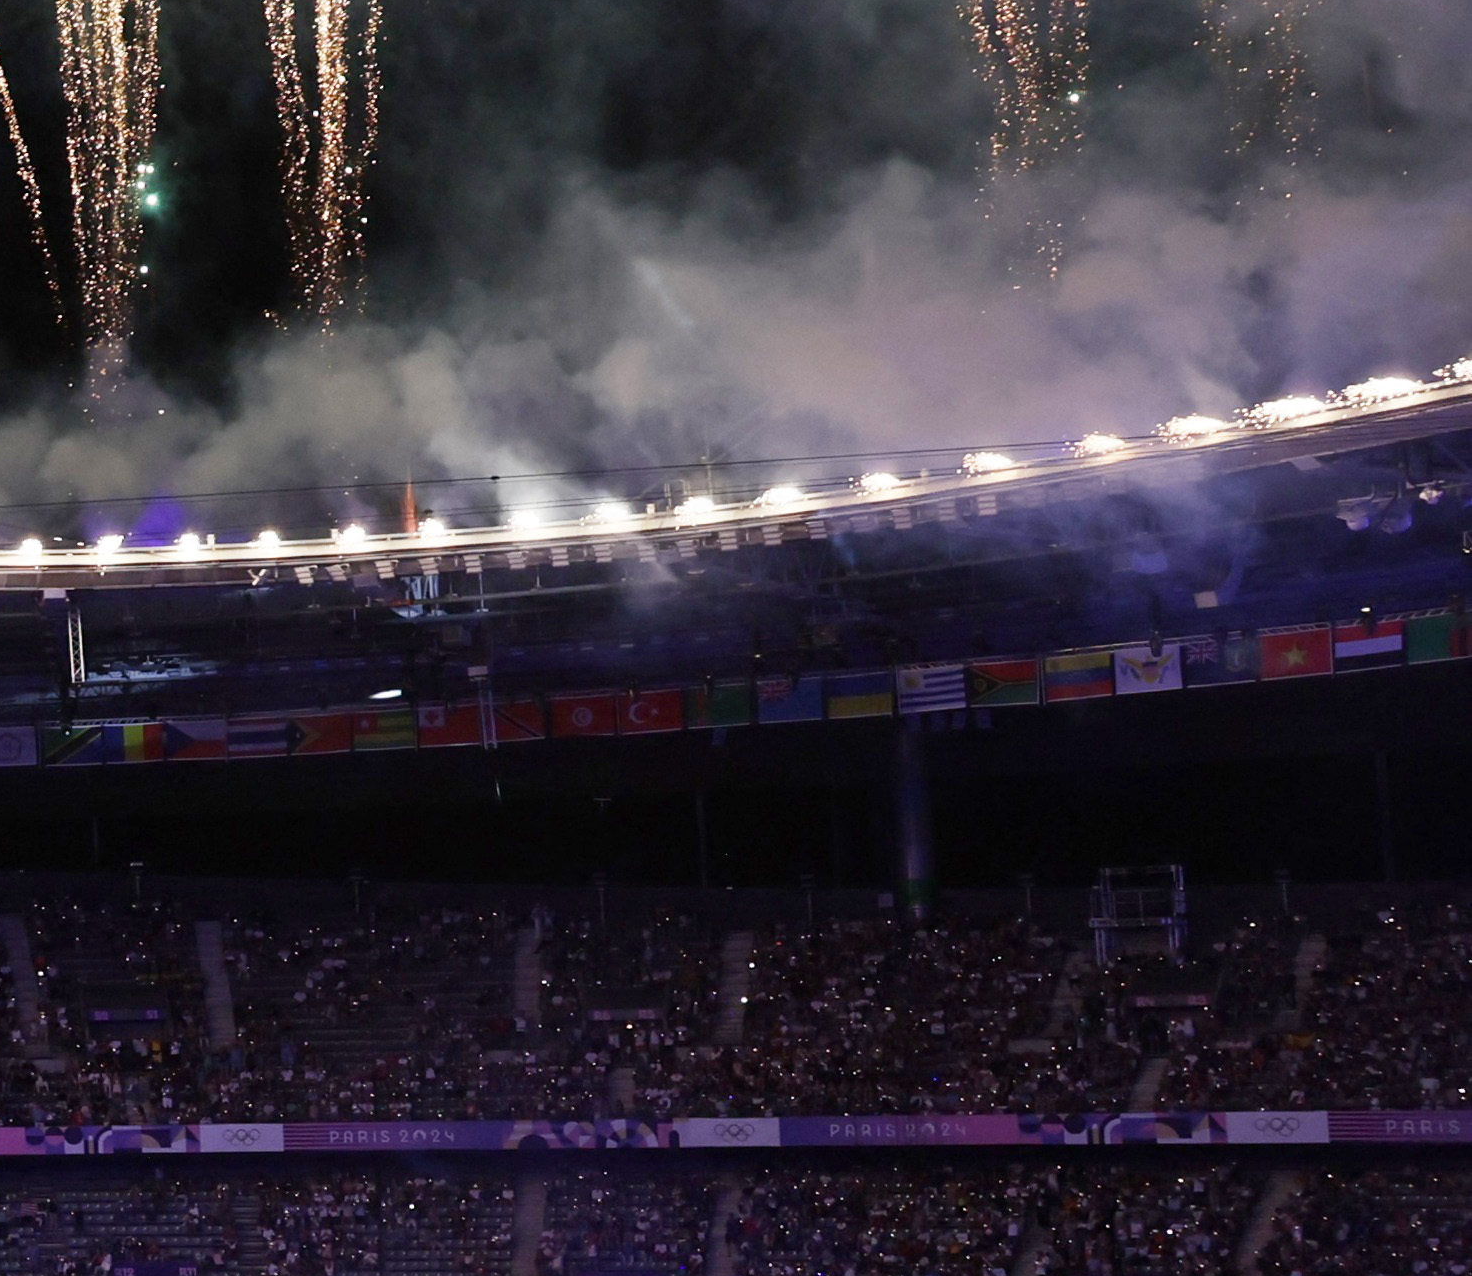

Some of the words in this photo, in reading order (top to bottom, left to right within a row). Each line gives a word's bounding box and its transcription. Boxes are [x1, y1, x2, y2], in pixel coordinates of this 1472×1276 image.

[146, 1010, 158, 1020] S1
[830, 1124, 896, 1137] PARIS
[905, 1123, 966, 1136] 2024
[1386, 1120, 1460, 1134] PARIS
[330, 1130, 391, 1143] PARIS
[399, 1130, 455, 1143] 2024
[178, 1267, 197, 1276] R11
